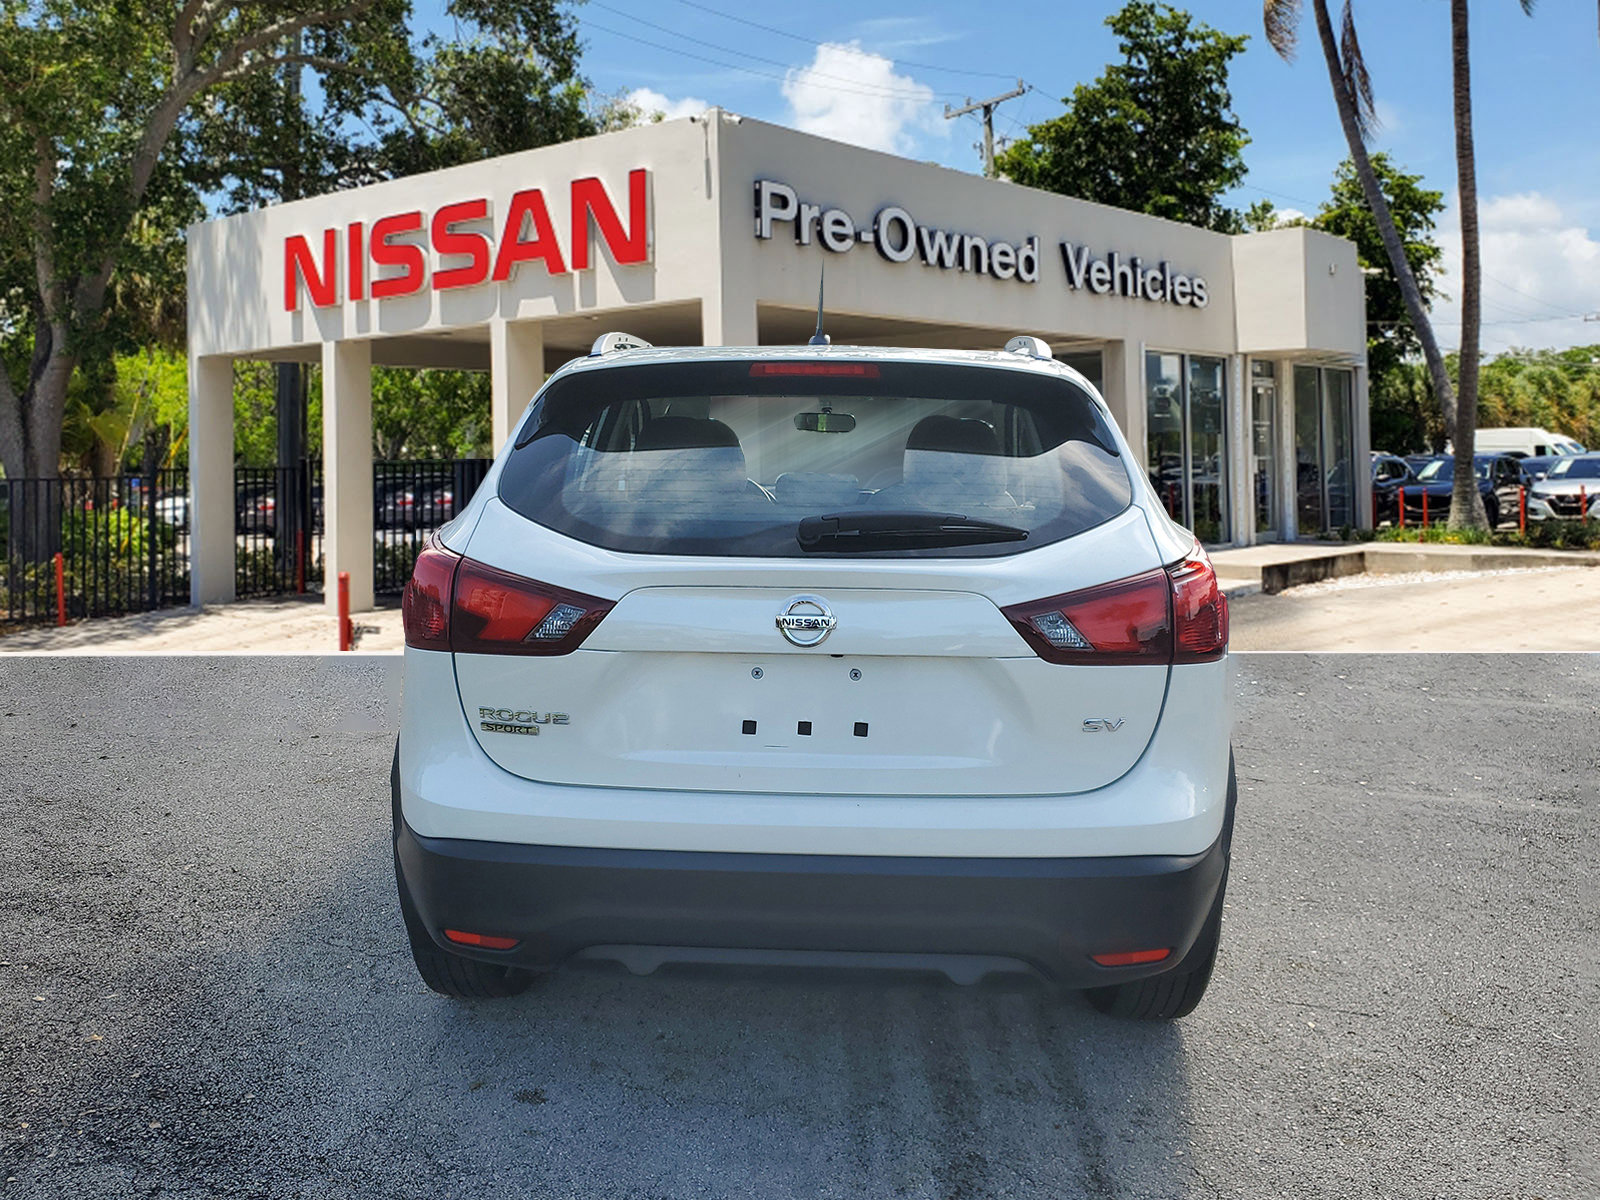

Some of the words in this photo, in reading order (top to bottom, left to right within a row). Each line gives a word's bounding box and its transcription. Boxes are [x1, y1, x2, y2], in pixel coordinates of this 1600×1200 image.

[284, 168, 647, 311] NISSAN
[755, 180, 1040, 284] Pre-Owned
[1061, 241, 1209, 308] Vehicles
[781, 618, 831, 627] NISSAN
[479, 706, 570, 725] ROGUE
[484, 722, 533, 734] SPORT
[1082, 717, 1126, 732] SV
